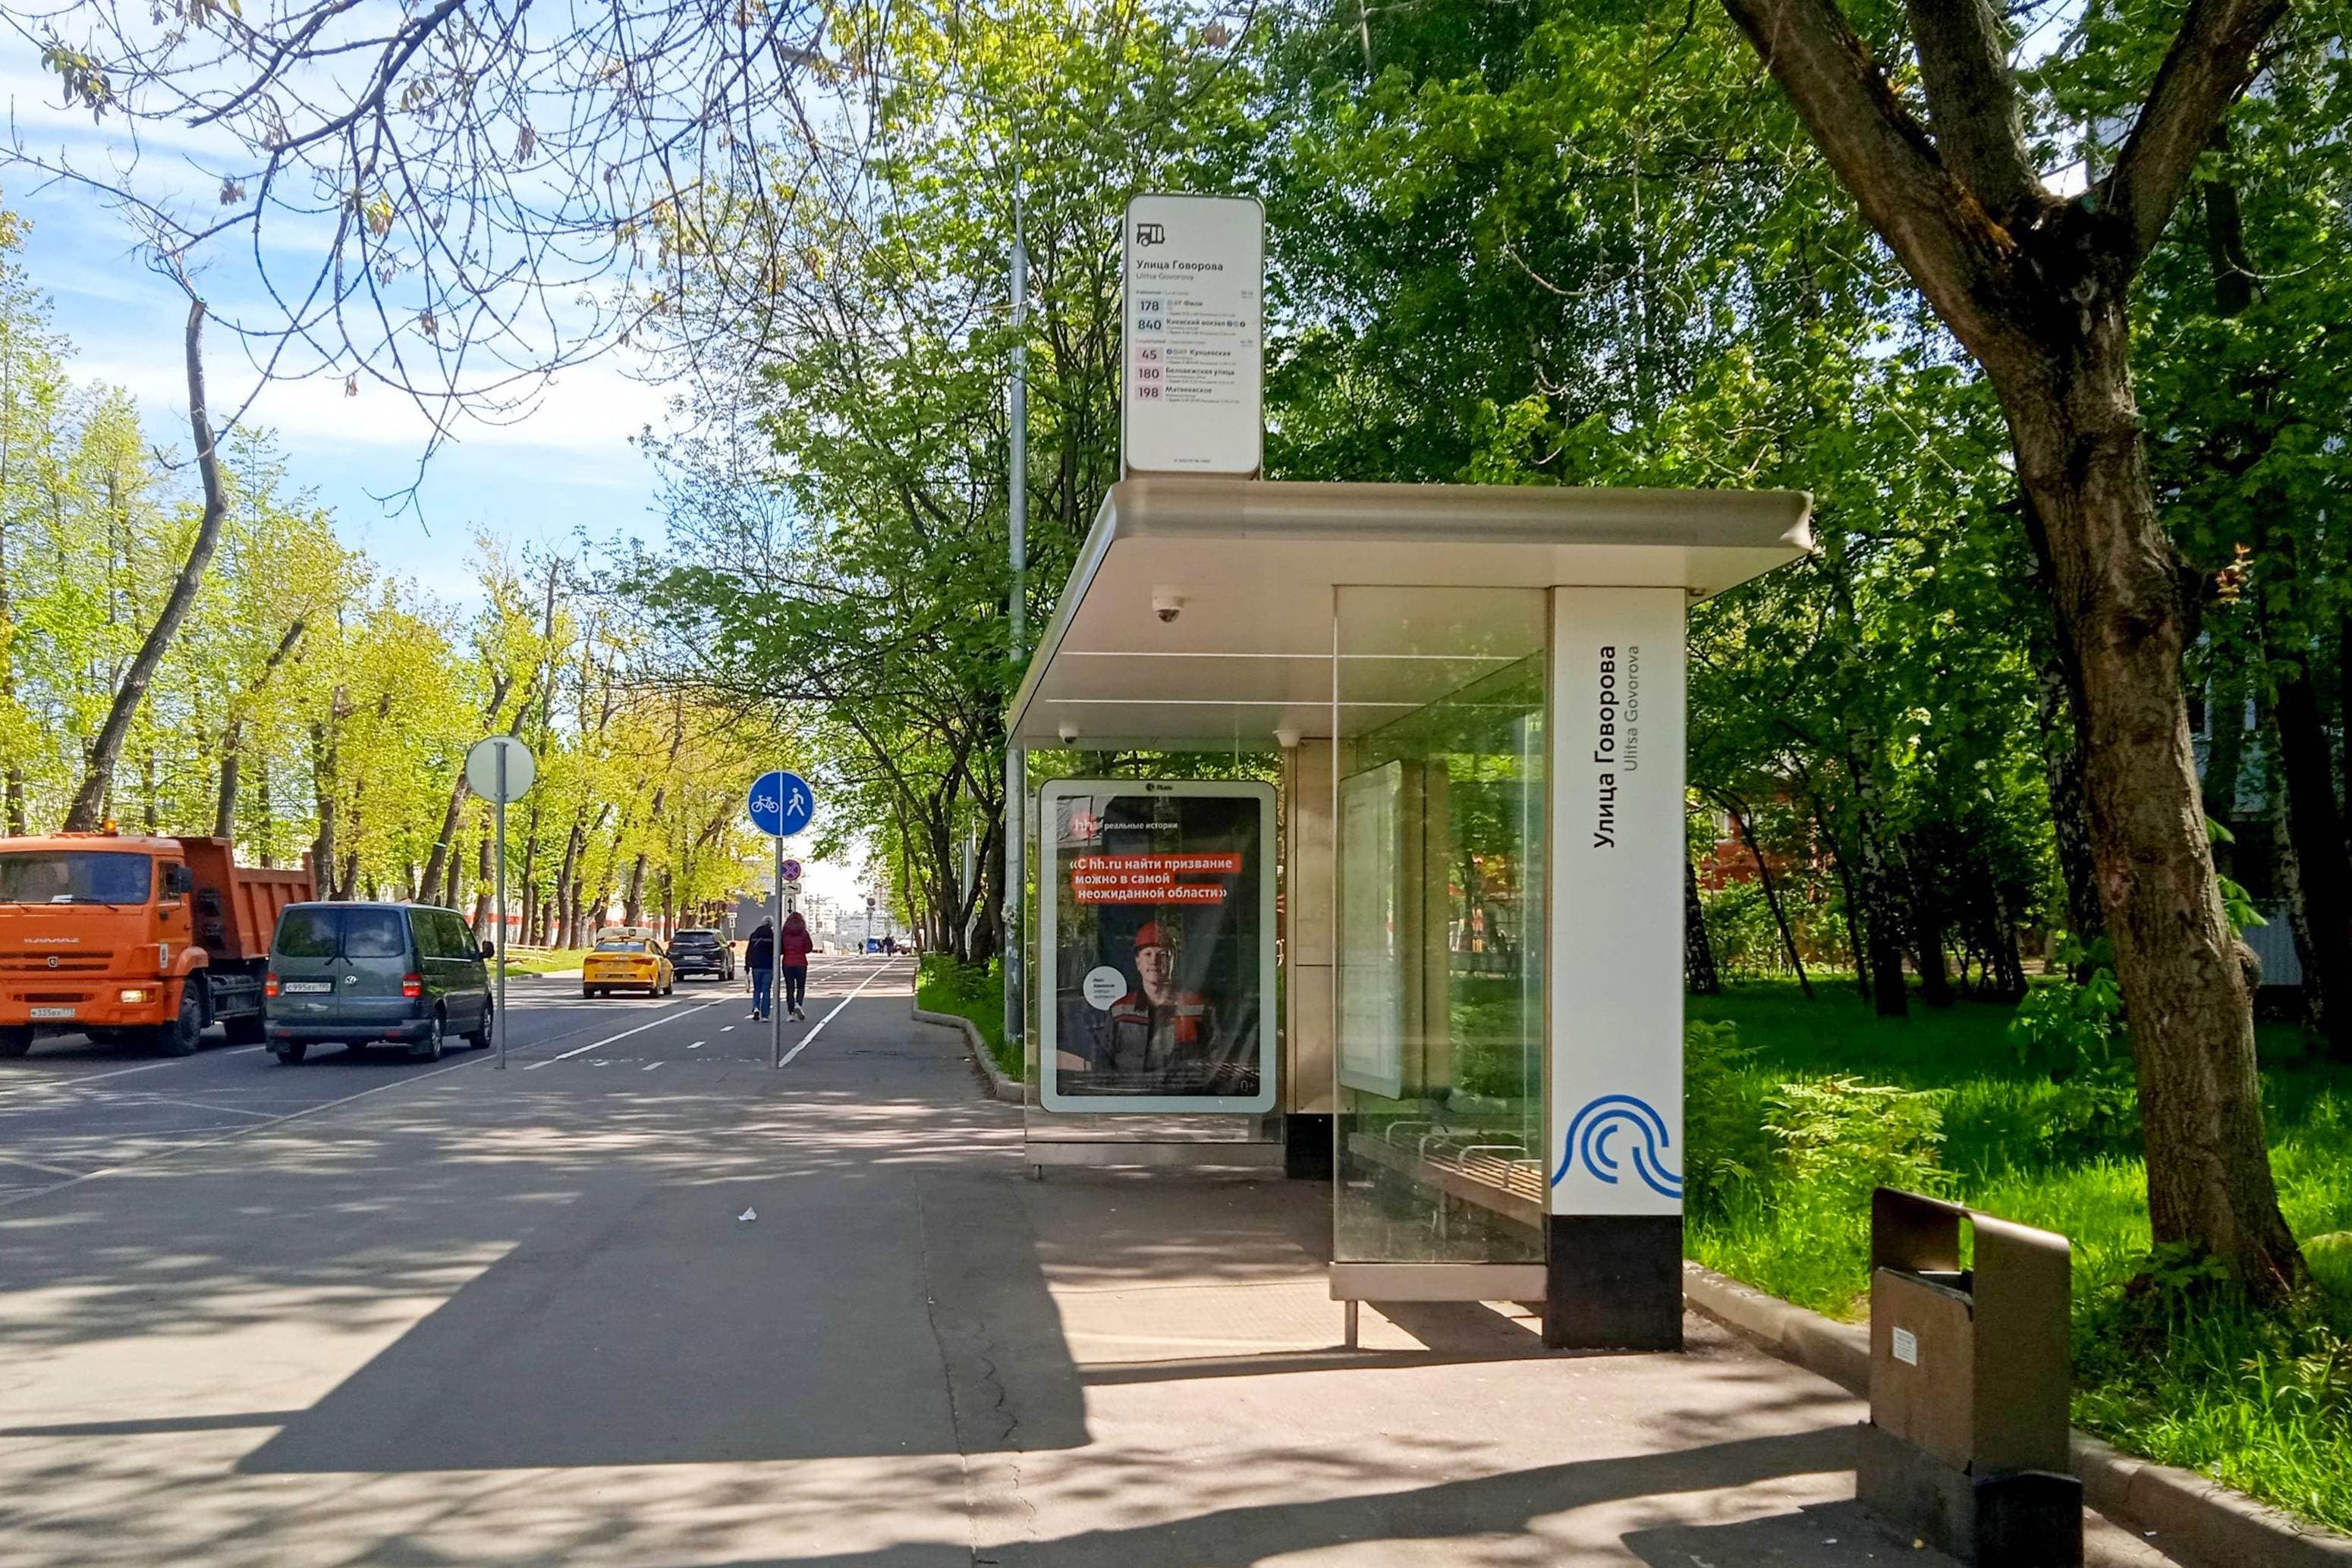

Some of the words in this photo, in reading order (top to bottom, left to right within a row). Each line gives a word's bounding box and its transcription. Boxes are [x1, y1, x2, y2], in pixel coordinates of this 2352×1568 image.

[1137, 259, 1169, 270] Улица
[1172, 260, 1223, 272] Говорова
[1140, 300, 1159, 311] 178
[1138, 320, 1162, 330] 840
[1142, 350, 1157, 360] 45
[1139, 369, 1159, 378] 180
[1139, 387, 1159, 397] 198
[1624, 646, 1639, 722] Govorova
[1594, 646, 1620, 763] Говорова
[1624, 727, 1638, 771] Ulitsa
[1593, 773, 1618, 849] Улица
[1104, 822, 1144, 831] реальные
[1146, 822, 1178, 831] истории
[1090, 859, 1122, 870] hh.ru
[1124, 858, 1161, 869] найти
[1165, 859, 1232, 871] призвание
[1075, 875, 1117, 885] можно
[1121, 875, 1127, 884] в
[1131, 872, 1170, 884] самой
[1078, 887, 1165, 900] неожиданной
[1168, 888, 1228, 898] области»
